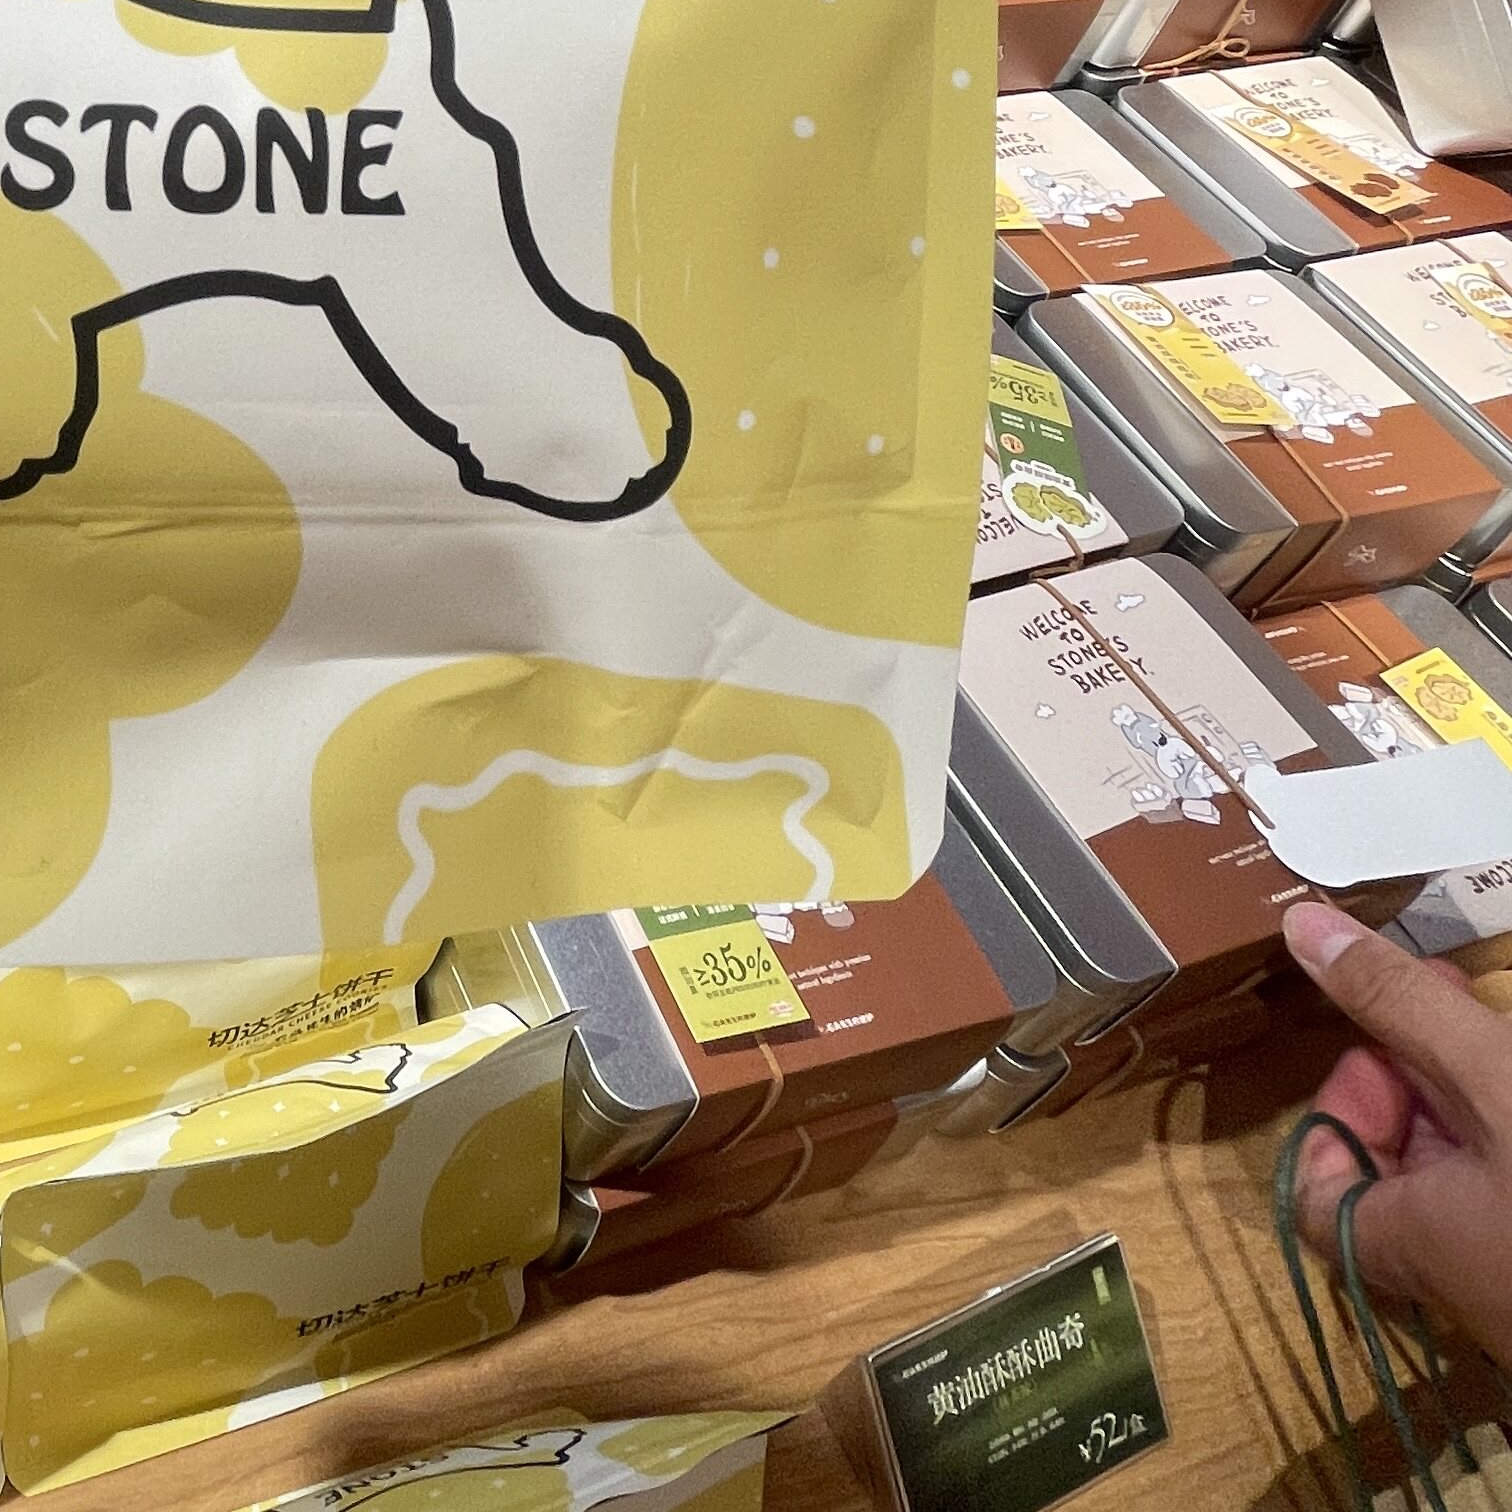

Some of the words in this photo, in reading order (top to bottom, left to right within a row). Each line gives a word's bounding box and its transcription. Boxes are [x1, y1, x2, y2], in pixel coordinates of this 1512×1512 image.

[0, 99, 406, 216] STONE
[1059, 628, 1084, 644] TO
[208, 968, 394, 1048] 切达芝士饼干
